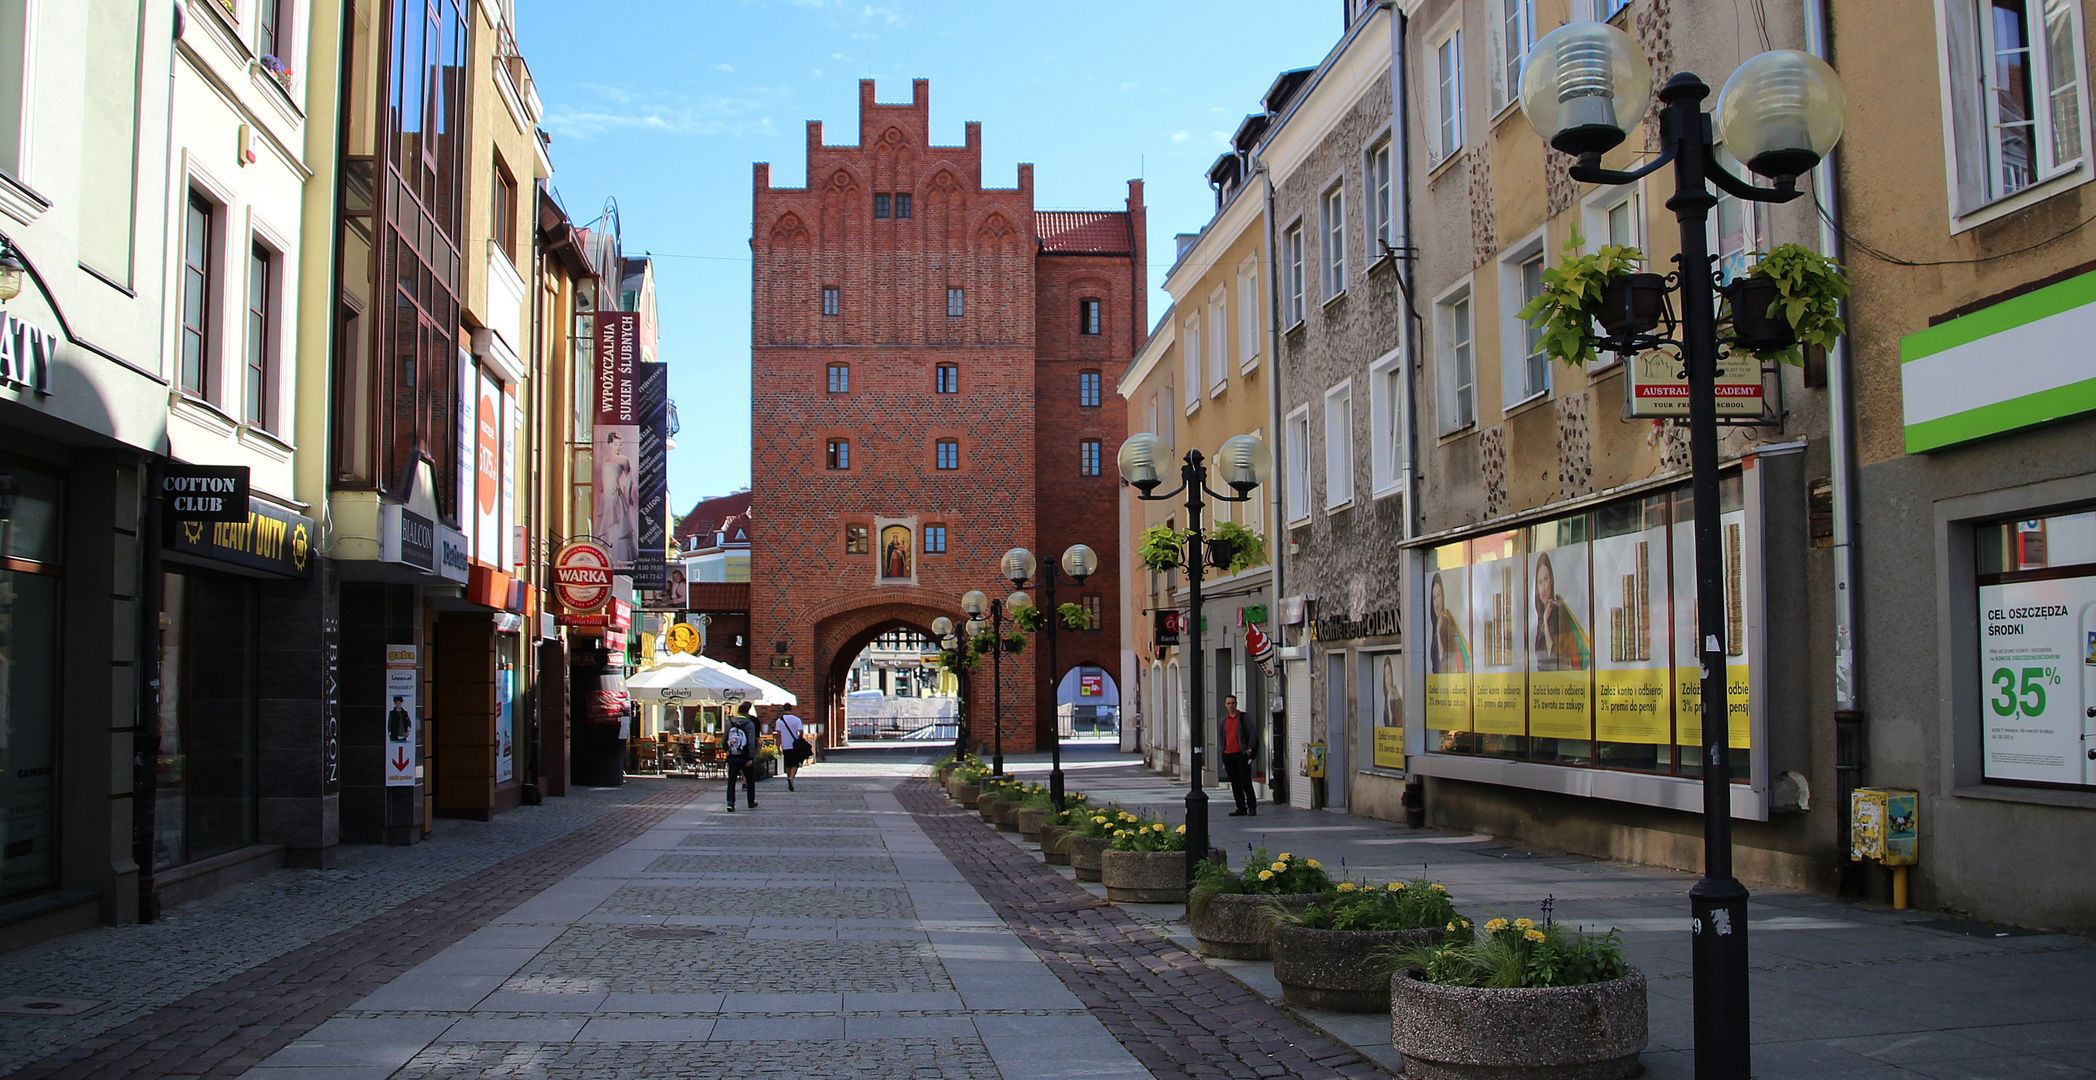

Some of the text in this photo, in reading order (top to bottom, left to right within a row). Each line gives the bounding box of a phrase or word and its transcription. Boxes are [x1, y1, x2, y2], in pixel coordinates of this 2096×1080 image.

[600, 323, 615, 413] WYPOŻYCZALNIA
[618, 315, 633, 421] SUKIEN ŚLUBNYCH
[639, 366, 664, 393] ryzjerstwo
[1643, 388, 1690, 396] AUSTRAL
[163, 476, 235, 493] COTTON
[174, 497, 222, 512] CLUB
[639, 495, 661, 516] Tattoo
[645, 515, 654, 526] &
[213, 512, 287, 560] HEAVY DUTY
[403, 517, 432, 550] BIALCON
[639, 523, 660, 544] Piercing
[647, 528, 664, 545] Studio
[558, 569, 608, 583] WARKA
[1988, 605, 2069, 620] CEL OSZCZĘDZA
[1317, 608, 1402, 642] Raiffeisen POLBAN
[1988, 623, 2024, 636] ŚRODKI
[388, 650, 415, 660] gaba
[661, 688, 691, 699] Carlsberg
[723, 688, 746, 699] Carlsberg
[1489, 684, 1500, 695] konto
[1504, 684, 1521, 698] odbieraj
[1533, 684, 1546, 695] Załóż
[1547, 684, 1560, 695] konto
[1564, 683, 1585, 698] odbieraj
[1600, 683, 1616, 696] Załóż
[1617, 683, 1633, 696] konto
[1638, 683, 1663, 699] odbieraj
[1682, 681, 1749, 695] Załóż odbie
[1497, 697, 1504, 707] do
[1533, 698, 1541, 709] 3%
[1541, 700, 1558, 709] zwrotu
[1566, 698, 1584, 713] zakupy
[1601, 699, 1657, 715] 3% premii do pensji
[1682, 699, 1693, 712] 3%
[329, 644, 338, 782] BIALCON
